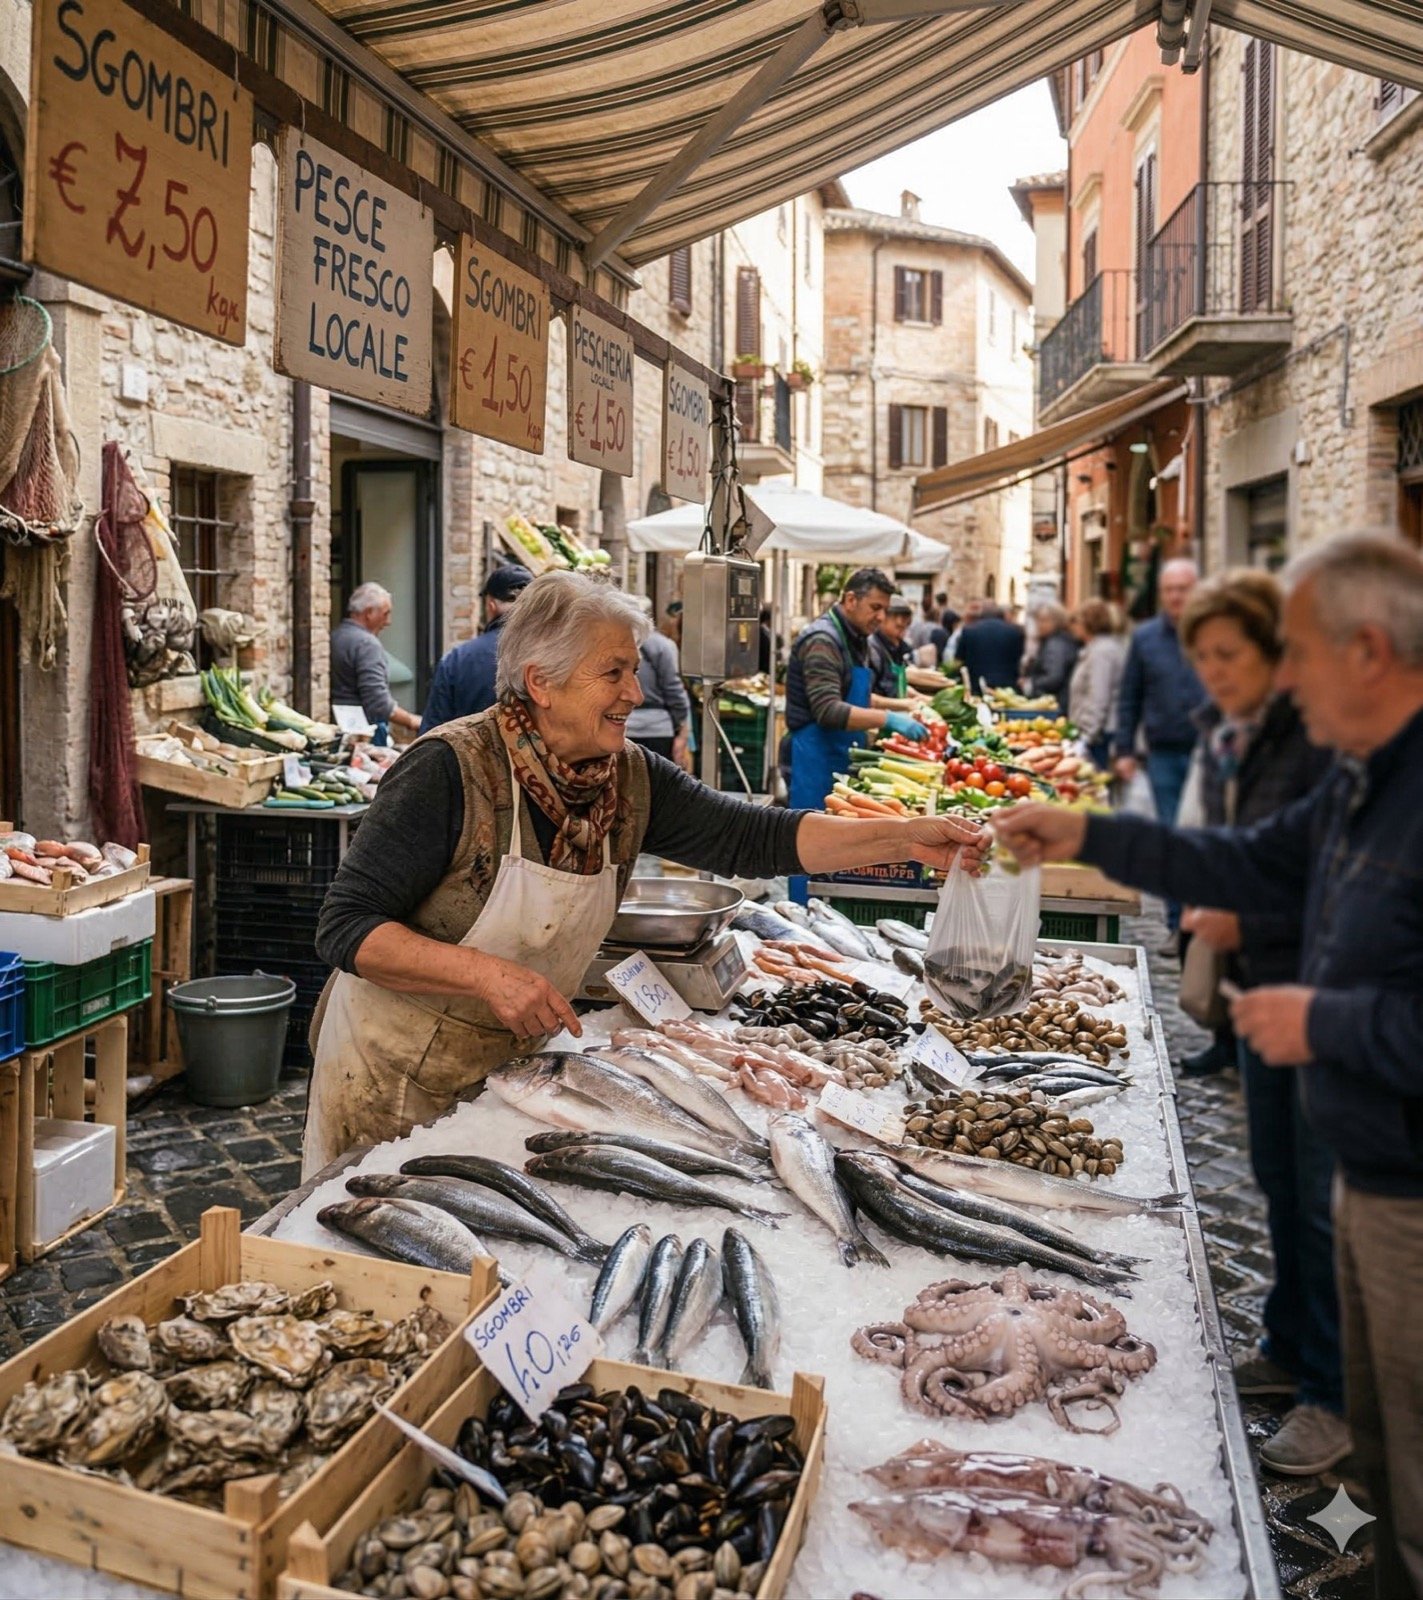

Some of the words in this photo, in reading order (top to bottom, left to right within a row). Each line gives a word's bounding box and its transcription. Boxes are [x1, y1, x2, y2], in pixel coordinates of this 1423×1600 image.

[54, 1, 230, 168] SGOMBRI
[294, 150, 388, 253] PESCE
[313, 236, 411, 319] FRESCO
[465, 256, 542, 342] SGOMBRI
[308, 302, 409, 383] LOCALE
[482, 335, 533, 419] 1,50
[574, 320, 634, 388] PESCHERIA
[590, 388, 626, 458] 1,50
[474, 1285, 534, 1350] SGOMBRI
